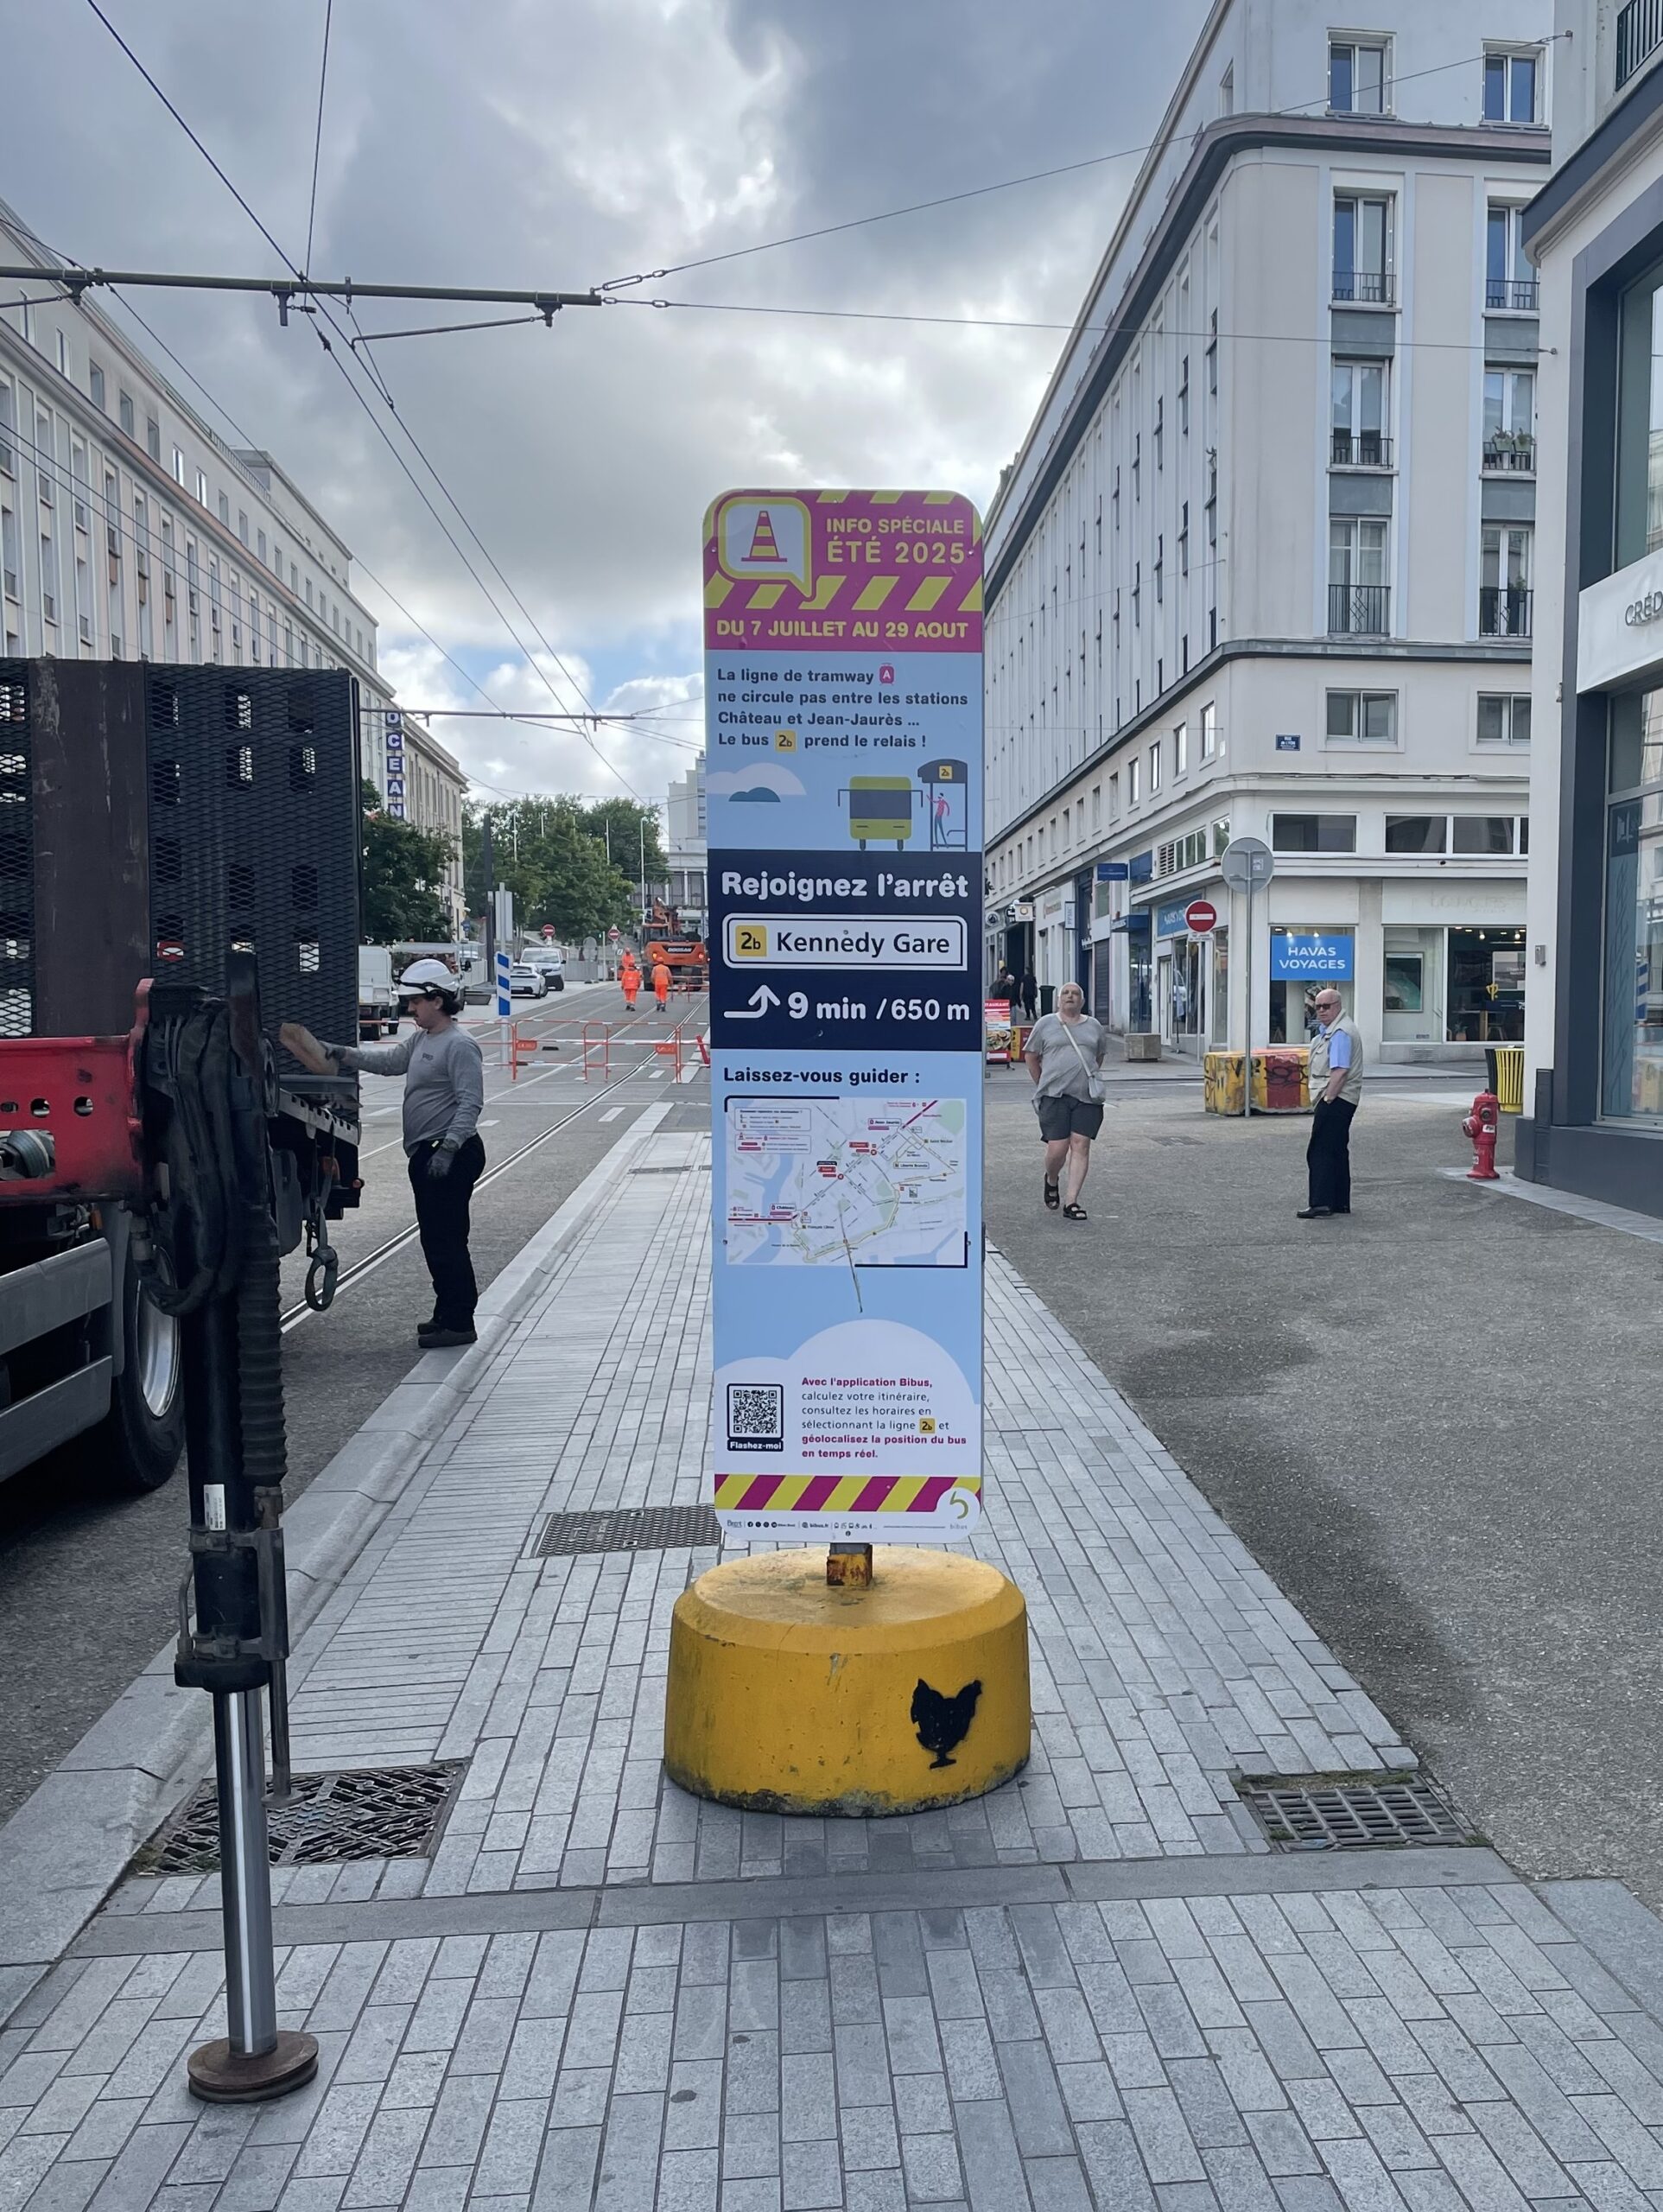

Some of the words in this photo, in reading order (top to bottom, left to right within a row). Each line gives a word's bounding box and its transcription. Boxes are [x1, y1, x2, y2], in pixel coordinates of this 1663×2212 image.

[827, 518, 872, 533] INFO
[878, 516, 964, 534] SPÉCIALE
[828, 536, 881, 563] ÉTÉ
[895, 541, 965, 563] 2025
[1625, 591, 1663, 626] CRÉD
[716, 620, 744, 636] DU
[751, 620, 762, 636] 7
[767, 620, 847, 637] JUILLET
[852, 621, 879, 638] AU
[885, 622, 908, 638] 29
[914, 621, 968, 639] AOUT
[717, 668, 735, 681] La
[740, 668, 778, 684] ligne
[784, 669, 803, 682] de
[808, 670, 874, 685] tramway
[718, 692, 736, 702] ne
[741, 690, 794, 703] circule
[799, 694, 827, 706] pas
[832, 692, 873, 704] entre
[878, 692, 900, 704] les
[905, 691, 968, 705] stations
[718, 710, 782, 725] Château
[787, 713, 803, 725] et
[807, 711, 903, 727] Jean-Jaurès
[718, 733, 736, 745] Le
[741, 733, 769, 746] bus
[778, 734, 793, 747] 2b
[804, 734, 849, 749] prend
[854, 734, 868, 747] le
[873, 734, 916, 747] relais
[721, 870, 867, 901] Rejoignez
[878, 872, 968, 898] l'arrêt
[740, 931, 761, 950] 2b
[777, 931, 885, 958] Kennedy
[893, 932, 950, 954] Gare
[1288, 947, 1336, 957] HAVAS
[1279, 959, 1346, 969] VOYAGES
[787, 991, 809, 1020] 9
[816, 997, 866, 1020] min
[947, 1003, 970, 1020] m
[724, 1066, 843, 1083] Laissez-vous
[848, 1067, 909, 1085] guider
[801, 1376, 828, 1386] Avec
[830, 1377, 896, 1389] l'application
[899, 1377, 932, 1389] Bibus,
[801, 1391, 844, 1401] calculez
[847, 1392, 875, 1401] votre
[878, 1391, 930, 1402] itinéraire,
[801, 1406, 852, 1415] consultez
[855, 1406, 869, 1415] les
[873, 1406, 916, 1415] horaires
[801, 1419, 873, 1430] sélectionnant
[876, 1420, 885, 1430] la
[889, 1420, 916, 1432] ligne
[938, 1421, 949, 1430] et
[730, 1441, 782, 1450] Flashez-moi
[802, 1434, 868, 1445] géolocalisez
[871, 1434, 881, 1444] la
[884, 1434, 928, 1445] position
[930, 1435, 944, 1444] du
[948, 1435, 967, 1445] bus
[802, 1449, 815, 1458] en
[817, 1449, 852, 1459] temps
[855, 1448, 879, 1459] réel.
